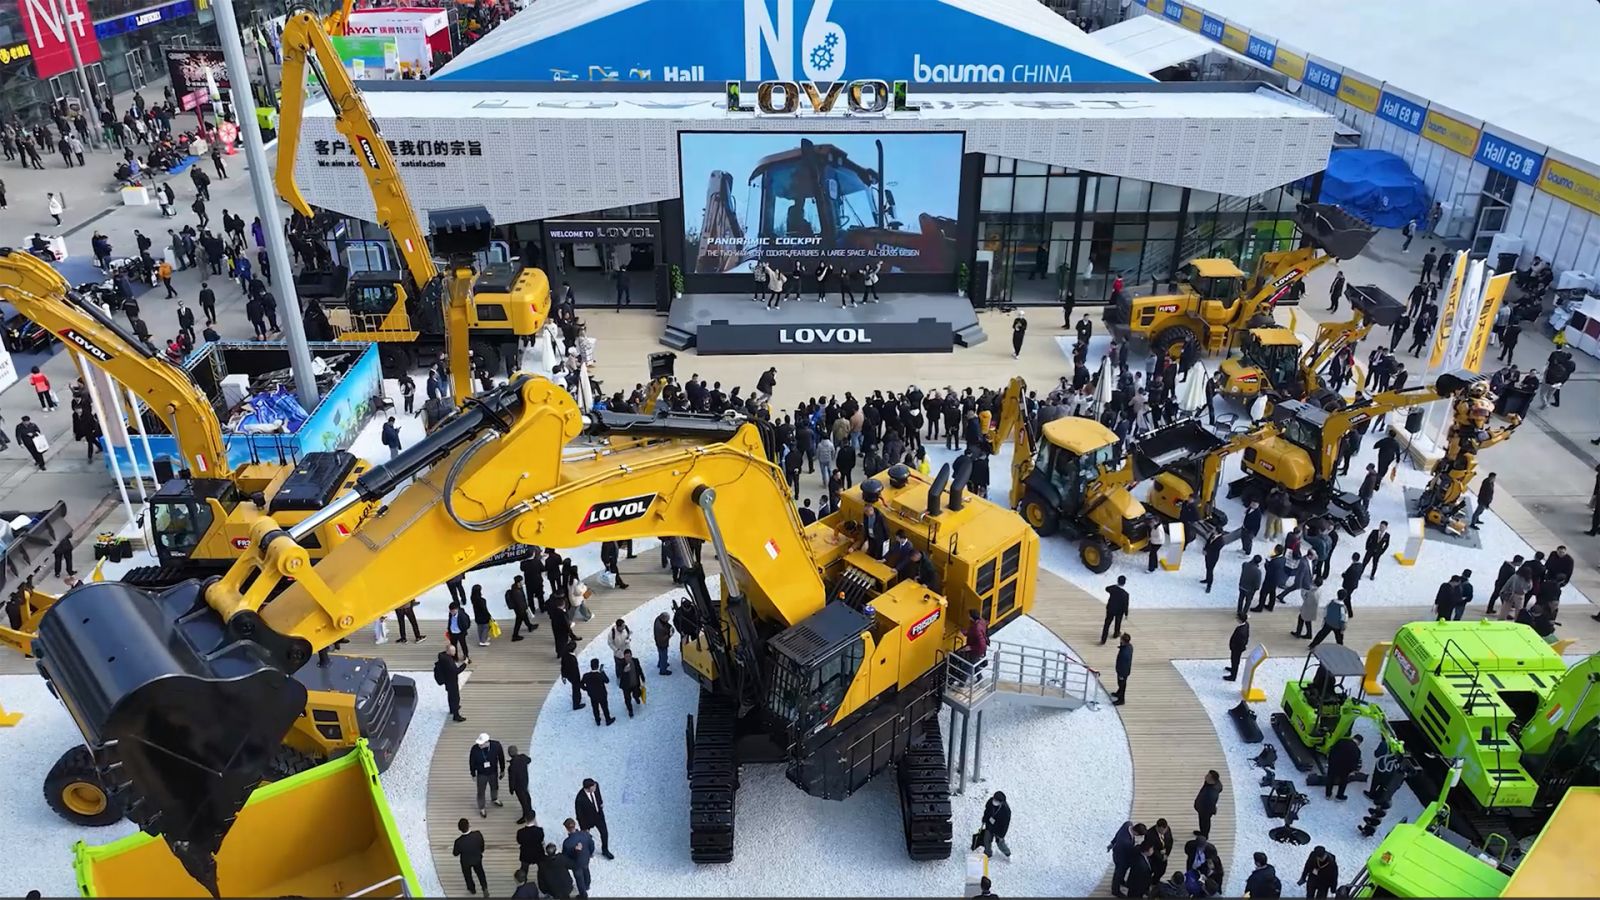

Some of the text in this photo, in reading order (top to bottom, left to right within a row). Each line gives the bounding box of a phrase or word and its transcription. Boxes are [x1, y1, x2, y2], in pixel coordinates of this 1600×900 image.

[744, 0, 846, 81] N6
[664, 65, 704, 81] Hall
[913, 54, 1072, 82] bauma CHINA
[1308, 67, 1320, 81] Hall
[726, 80, 921, 113] LOVOL
[1382, 100, 1398, 118] Hall
[1399, 105, 1411, 121] E8
[314, 139, 482, 156] 客户是我们的宗旨
[361, 139, 378, 169] LOVOL
[1483, 141, 1506, 164] Hall
[1505, 151, 1522, 170] E8
[317, 159, 330, 167] We
[401, 159, 446, 168] satisfaction
[550, 227, 655, 238] WELCOME TO LOVOL
[707, 237, 822, 245] PANORAMIC COCKPIT
[827, 249, 846, 257] LARGE
[847, 249, 866, 257] SPACE
[1274, 270, 1299, 287] LOVOL
[779, 327, 872, 343] LOVOL
[67, 331, 109, 361] LOVOL
[588, 499, 647, 524] LOVOL
